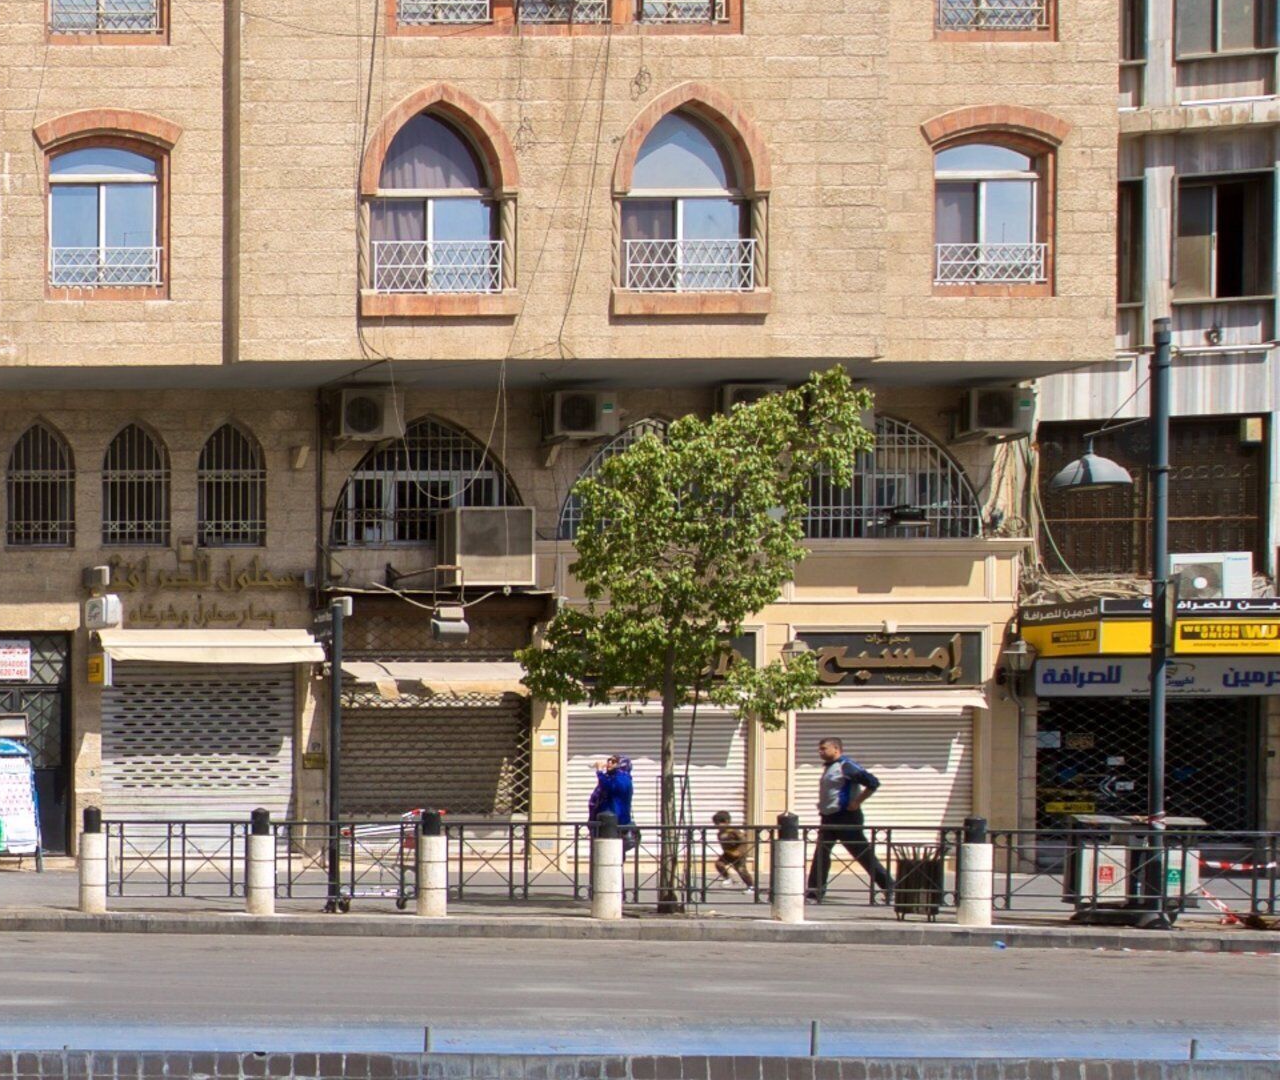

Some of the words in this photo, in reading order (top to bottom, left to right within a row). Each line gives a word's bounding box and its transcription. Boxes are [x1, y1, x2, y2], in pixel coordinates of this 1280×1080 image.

[1023, 608, 1061, 621] للصرافة
[1062, 606, 1099, 620] الحرمين
[1182, 625, 1240, 633] WESTERN
[1243, 624, 1279, 639] WU
[1042, 665, 1122, 689] للصرافة
